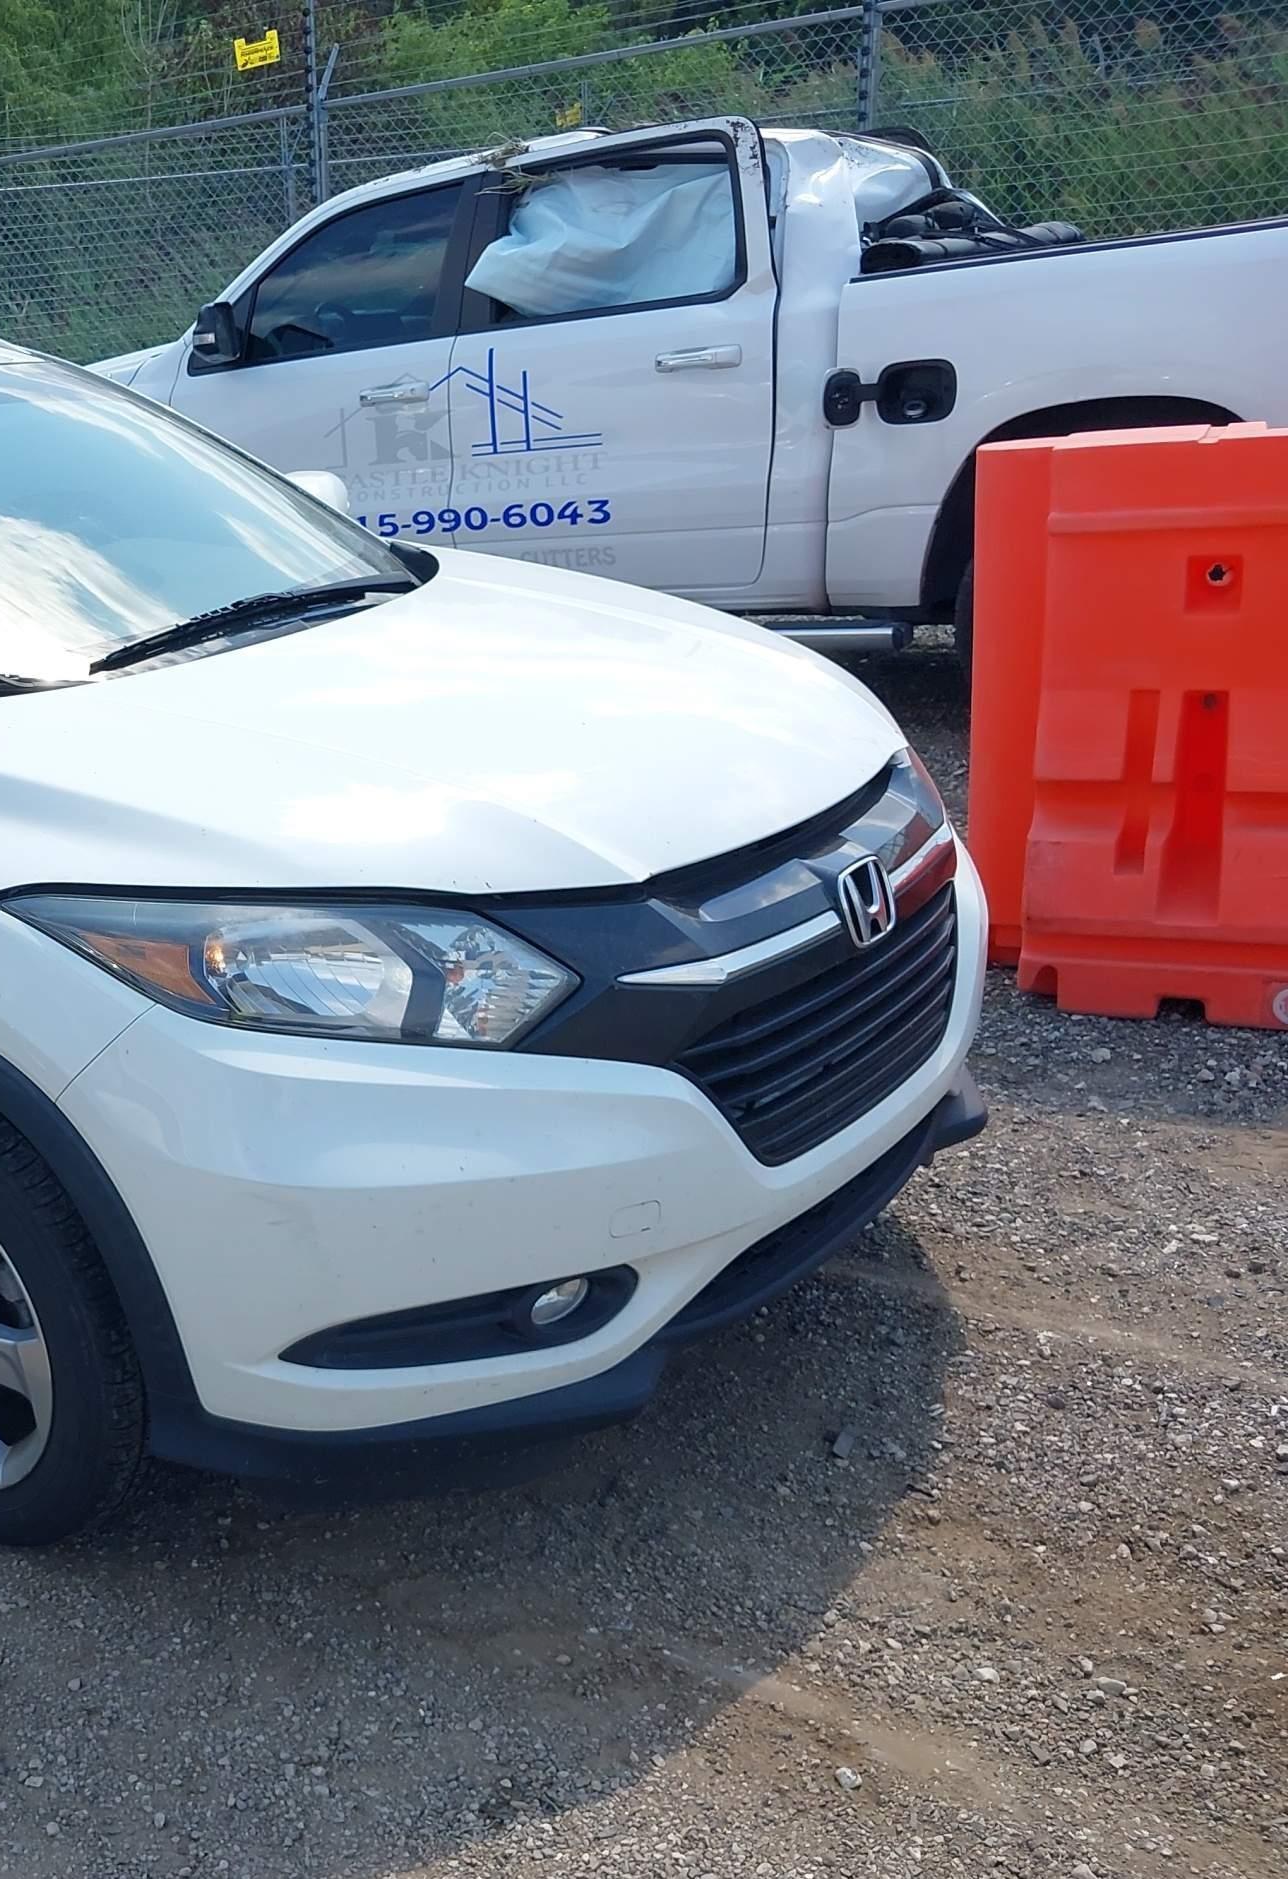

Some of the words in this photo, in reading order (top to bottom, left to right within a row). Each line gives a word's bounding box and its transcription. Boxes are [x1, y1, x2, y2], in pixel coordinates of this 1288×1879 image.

[344, 466, 449, 489] ASTLE
[461, 452, 608, 482] KNIGHT
[348, 478, 530, 502] ONSTRUCTION
[545, 473, 589, 488] LLC
[357, 500, 611, 537] 15-990-6043
